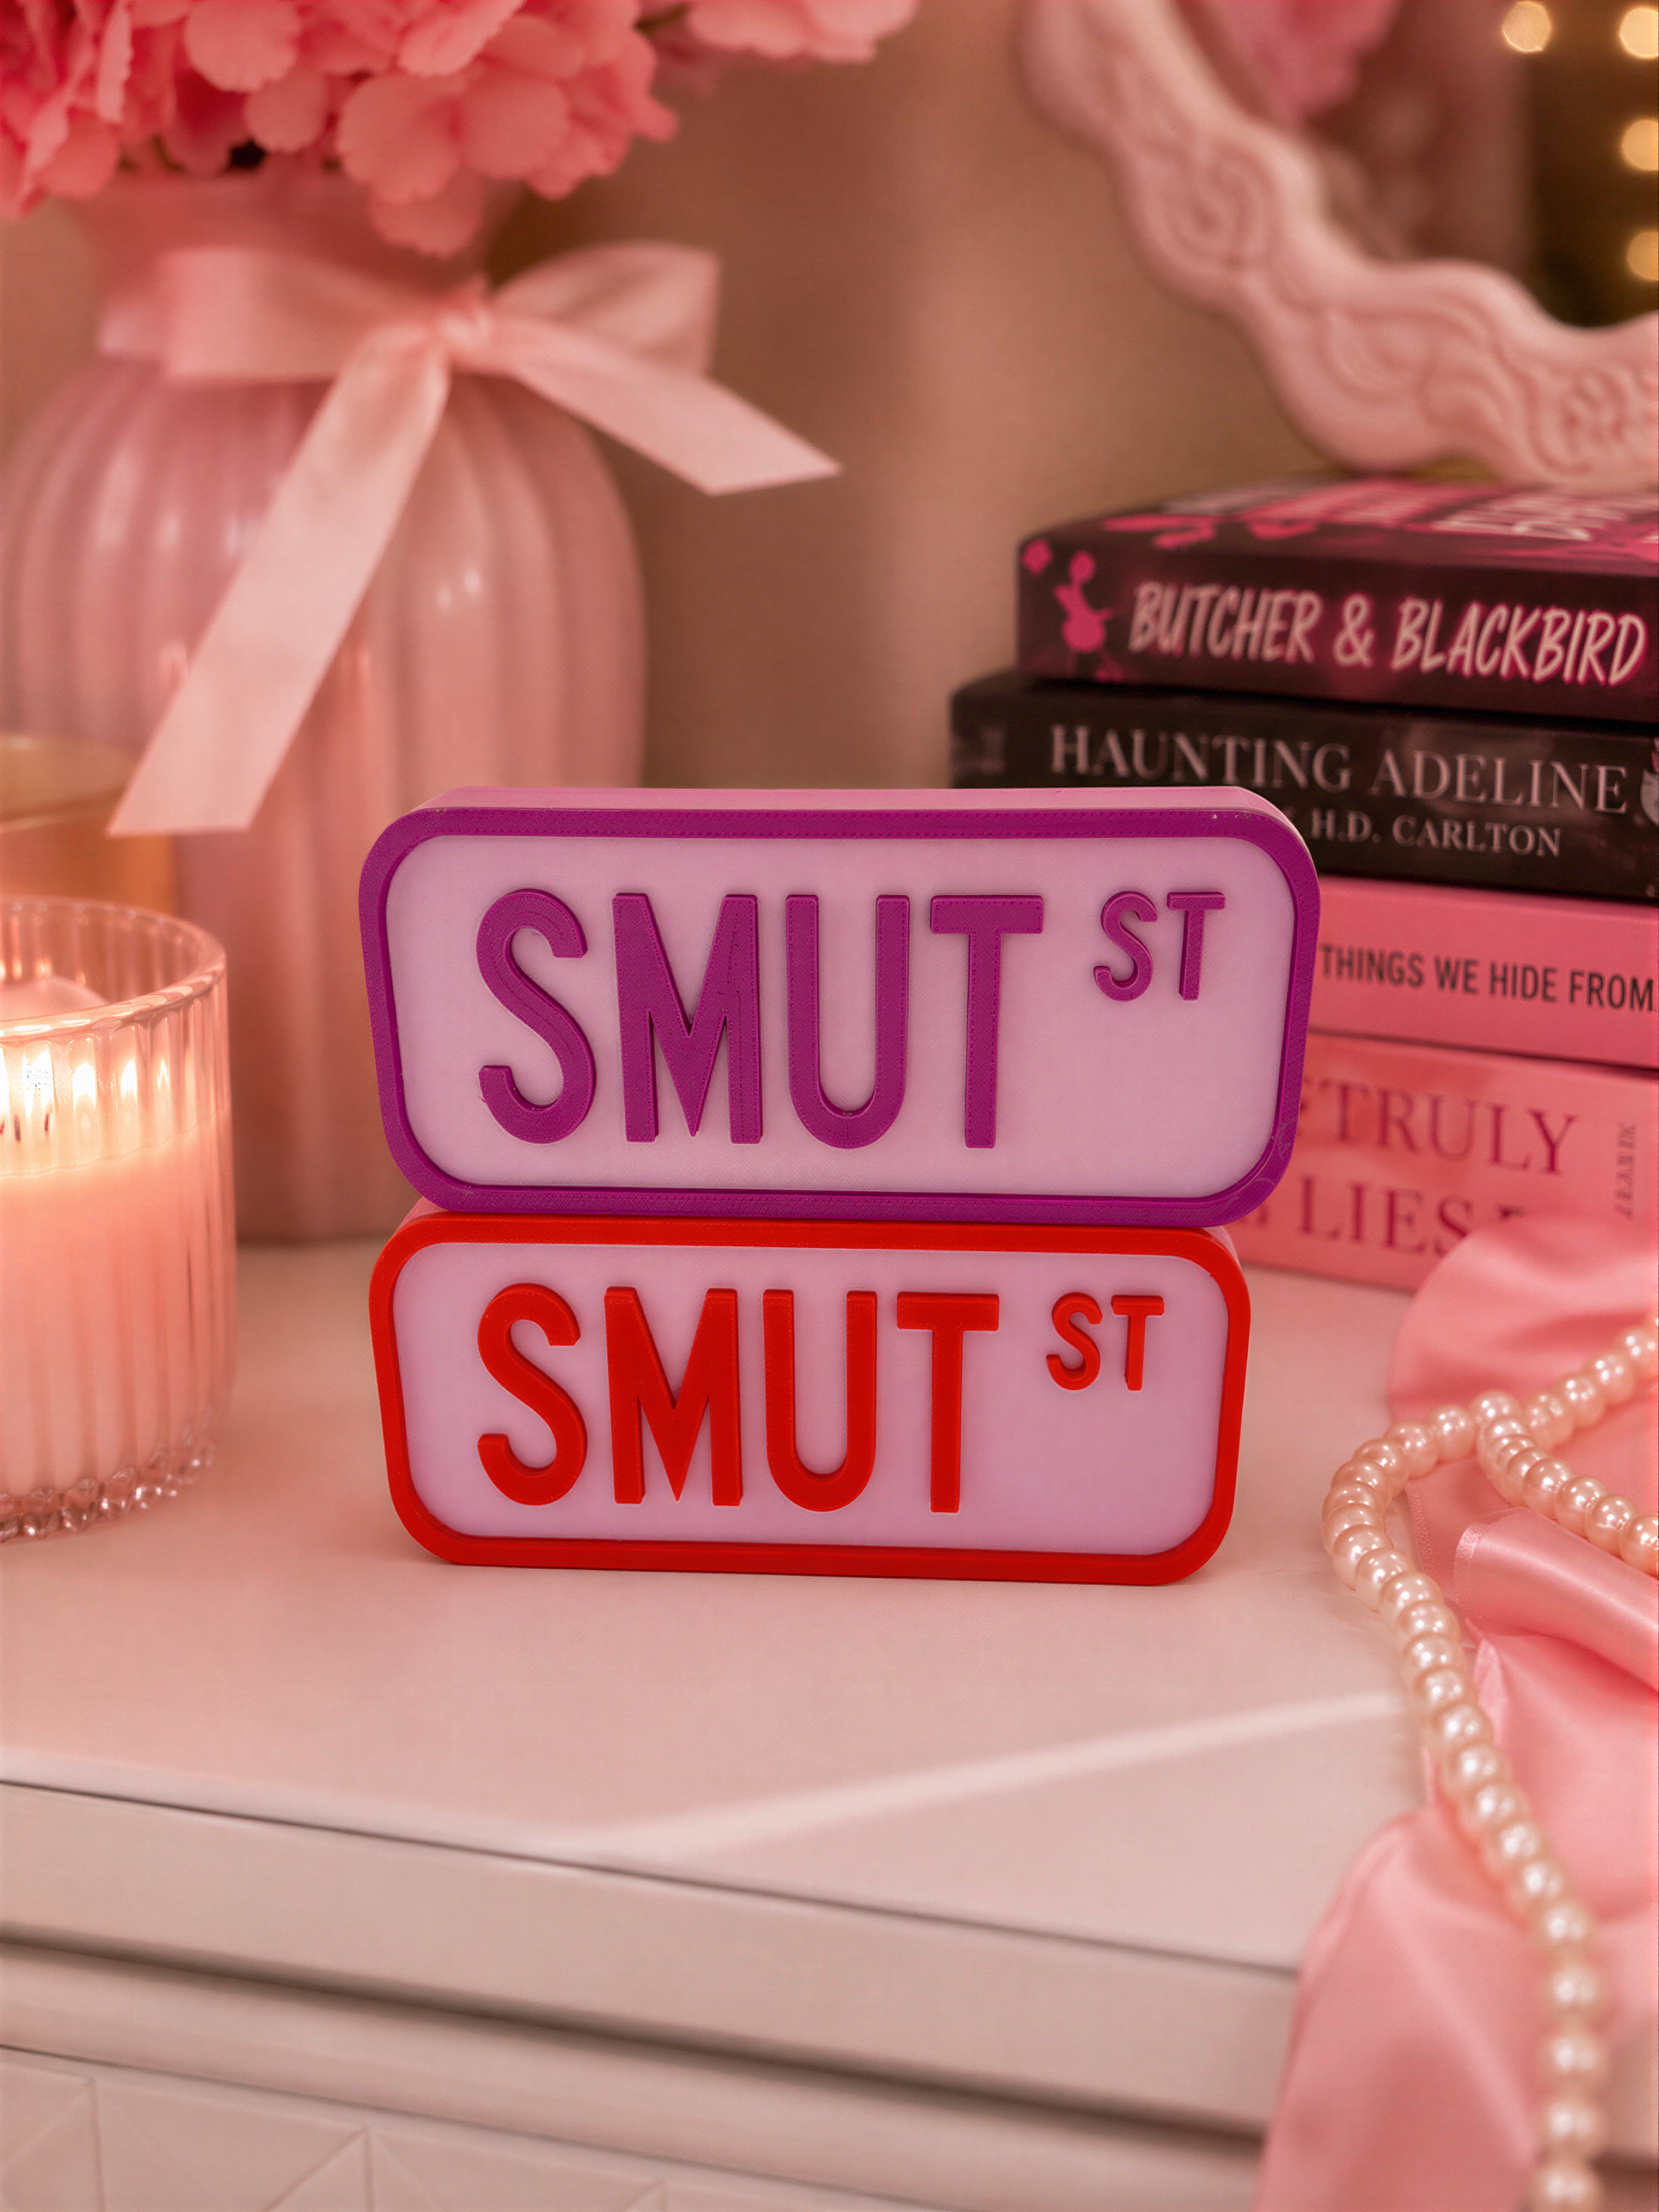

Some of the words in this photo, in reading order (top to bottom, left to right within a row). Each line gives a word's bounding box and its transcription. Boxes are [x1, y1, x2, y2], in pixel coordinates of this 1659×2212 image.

[1128, 581, 1324, 665] BUTCHER
[1332, 593, 1374, 668] &
[1390, 597, 1646, 684] BLACKBIRD
[1050, 724, 1353, 794] HAUNTING
[1371, 750, 1628, 815] ADELINE
[1311, 807, 1381, 845] H.D.
[1391, 814, 1562, 858] CARLTON
[476, 887, 1044, 1148] SMUT
[1093, 890, 1226, 1002] ST
[1321, 944, 1425, 989] THINGS
[1435, 956, 1479, 995] WE
[1489, 962, 1558, 1003] HIDE
[1570, 970, 1654, 1013] FROM
[1299, 1076, 1579, 1177] TRULY
[476, 1282, 1001, 1515] SMUT
[1045, 1291, 1165, 1392] ST
